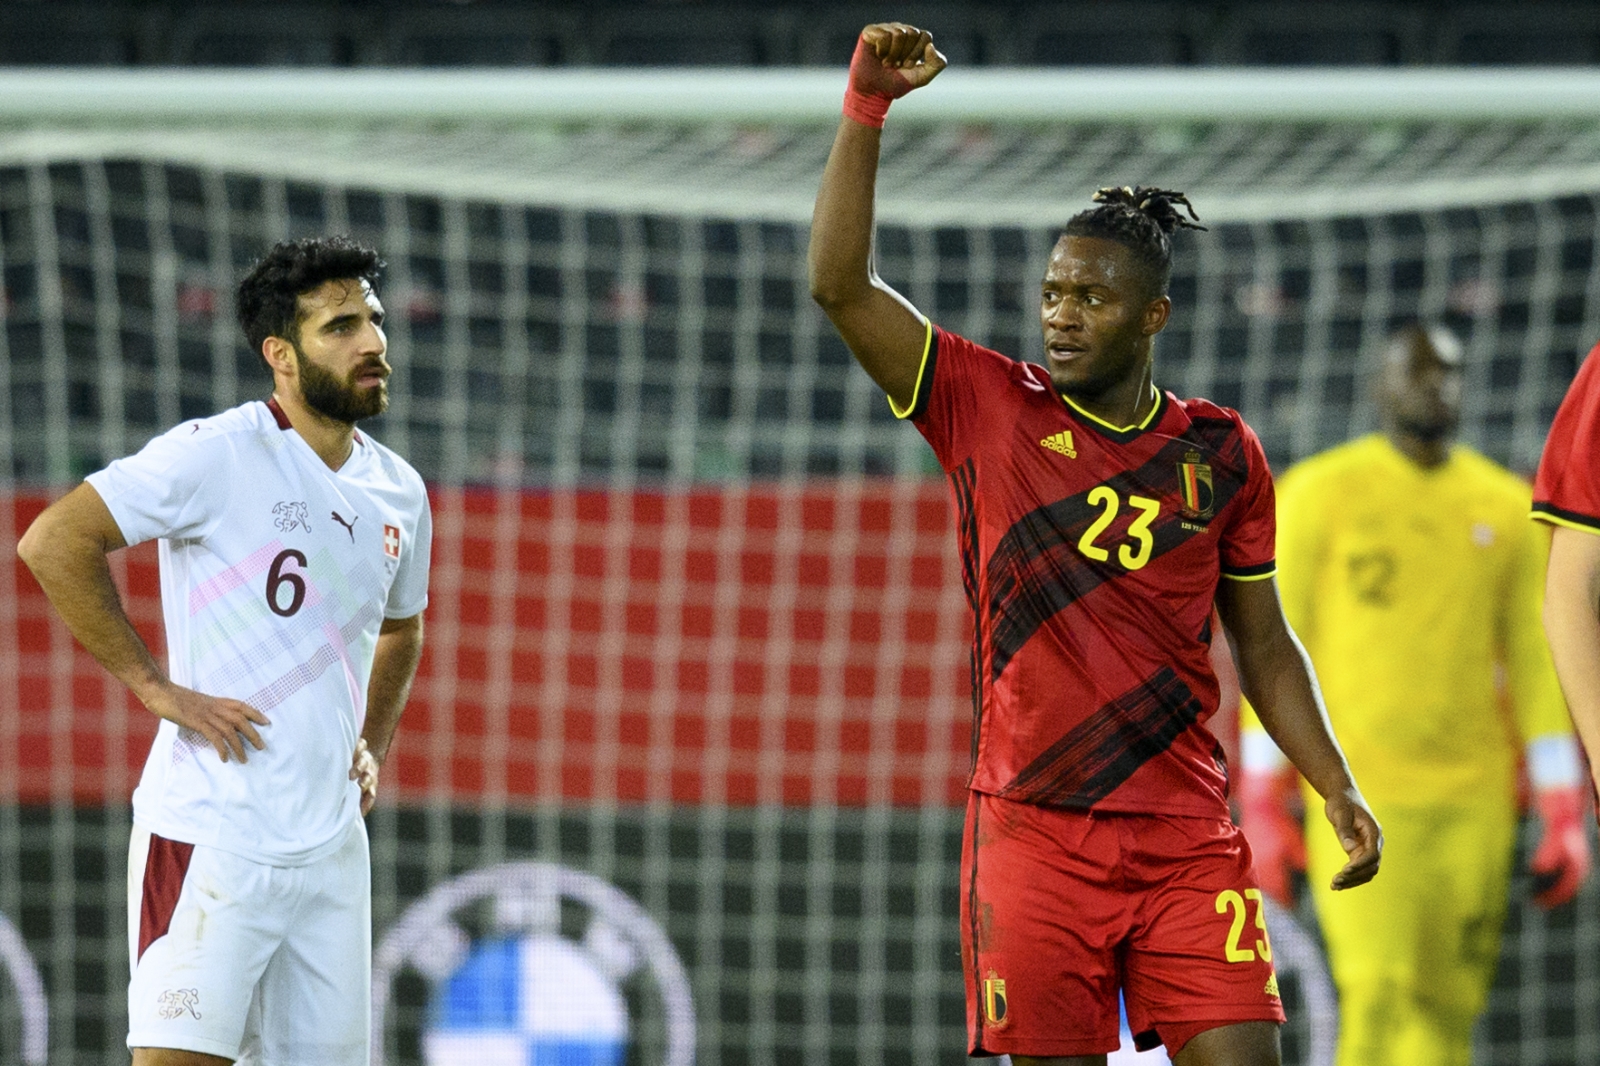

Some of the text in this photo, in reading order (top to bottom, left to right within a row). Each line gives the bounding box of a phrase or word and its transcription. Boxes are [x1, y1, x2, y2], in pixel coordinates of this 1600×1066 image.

[1040, 439, 1077, 459] adidas
[1078, 486, 1160, 570] 23
[266, 548, 308, 618] 6
